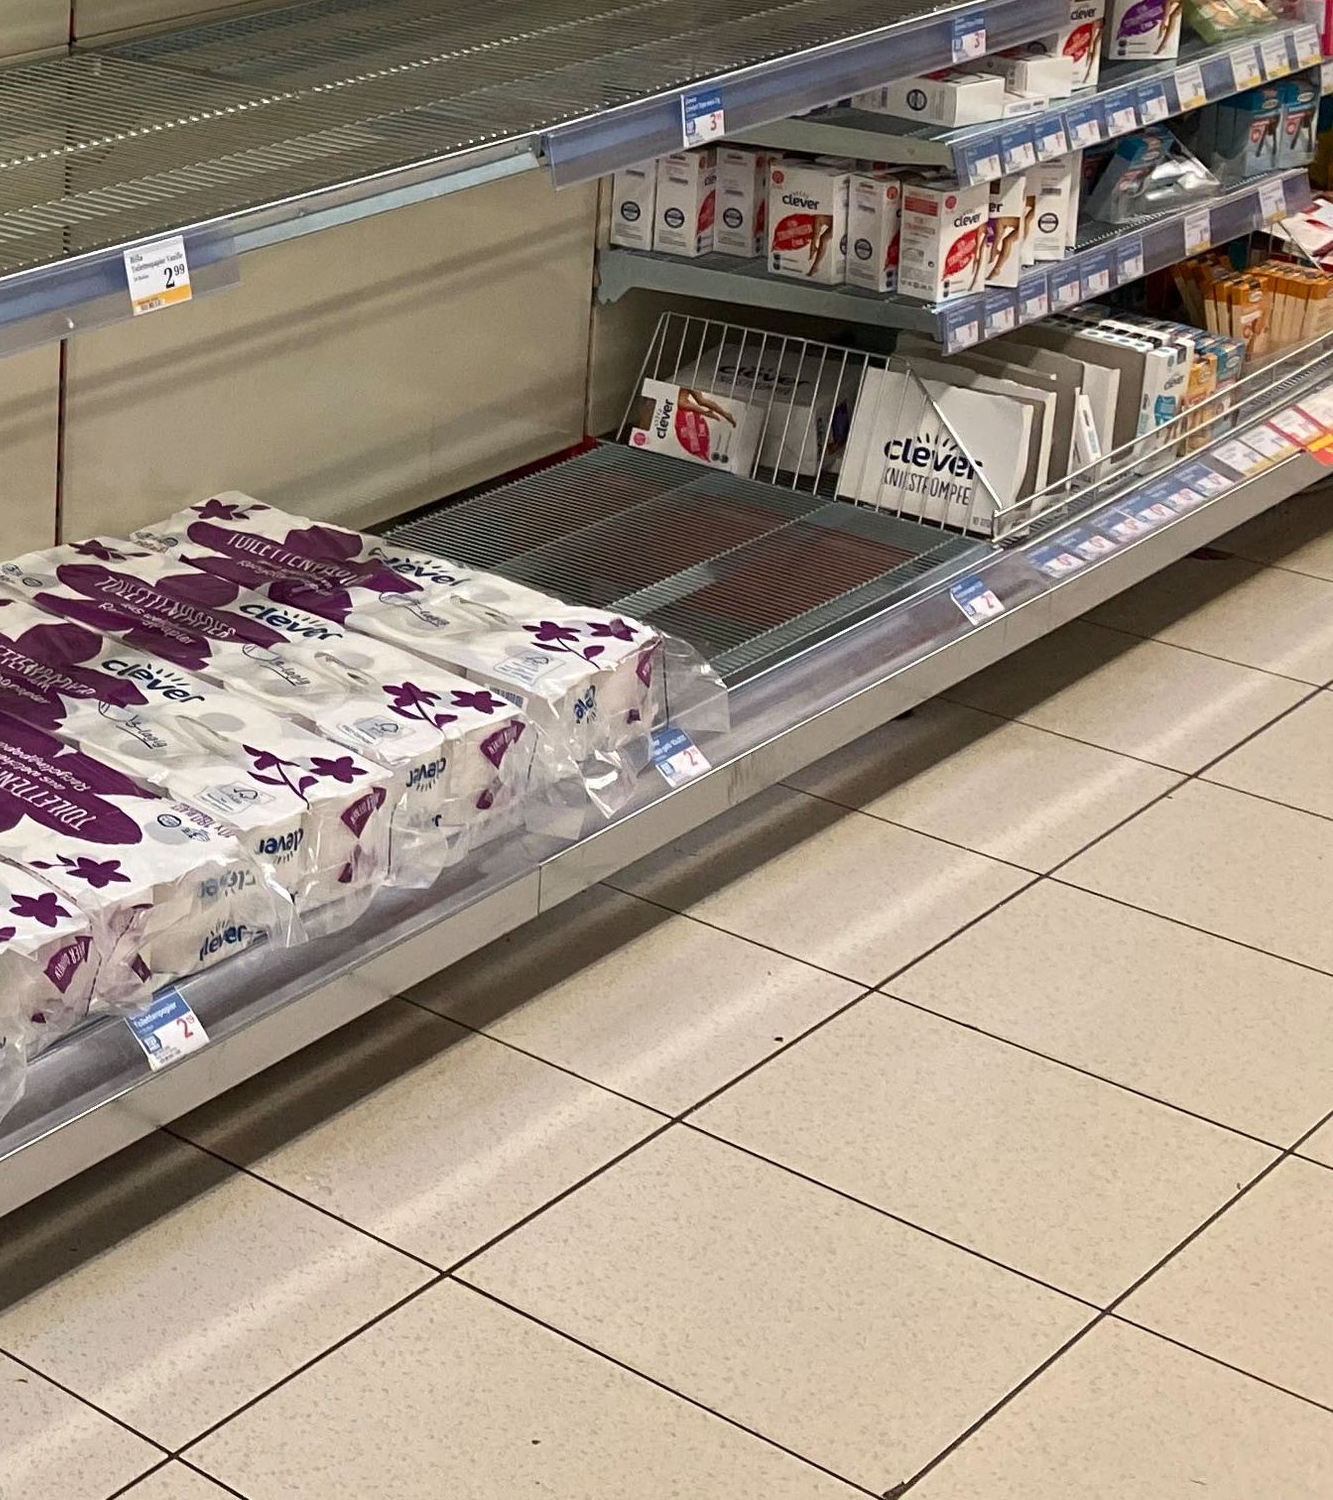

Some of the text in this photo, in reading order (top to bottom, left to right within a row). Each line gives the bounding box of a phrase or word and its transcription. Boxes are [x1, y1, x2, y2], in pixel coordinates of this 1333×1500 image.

[1071, 7, 1097, 21] clever
[782, 193, 820, 211] clever
[954, 213, 982, 229] clever
[658, 398, 675, 440] clever
[883, 437, 984, 479] clever
[239, 602, 343, 643] clever
[101, 657, 206, 705] clever
